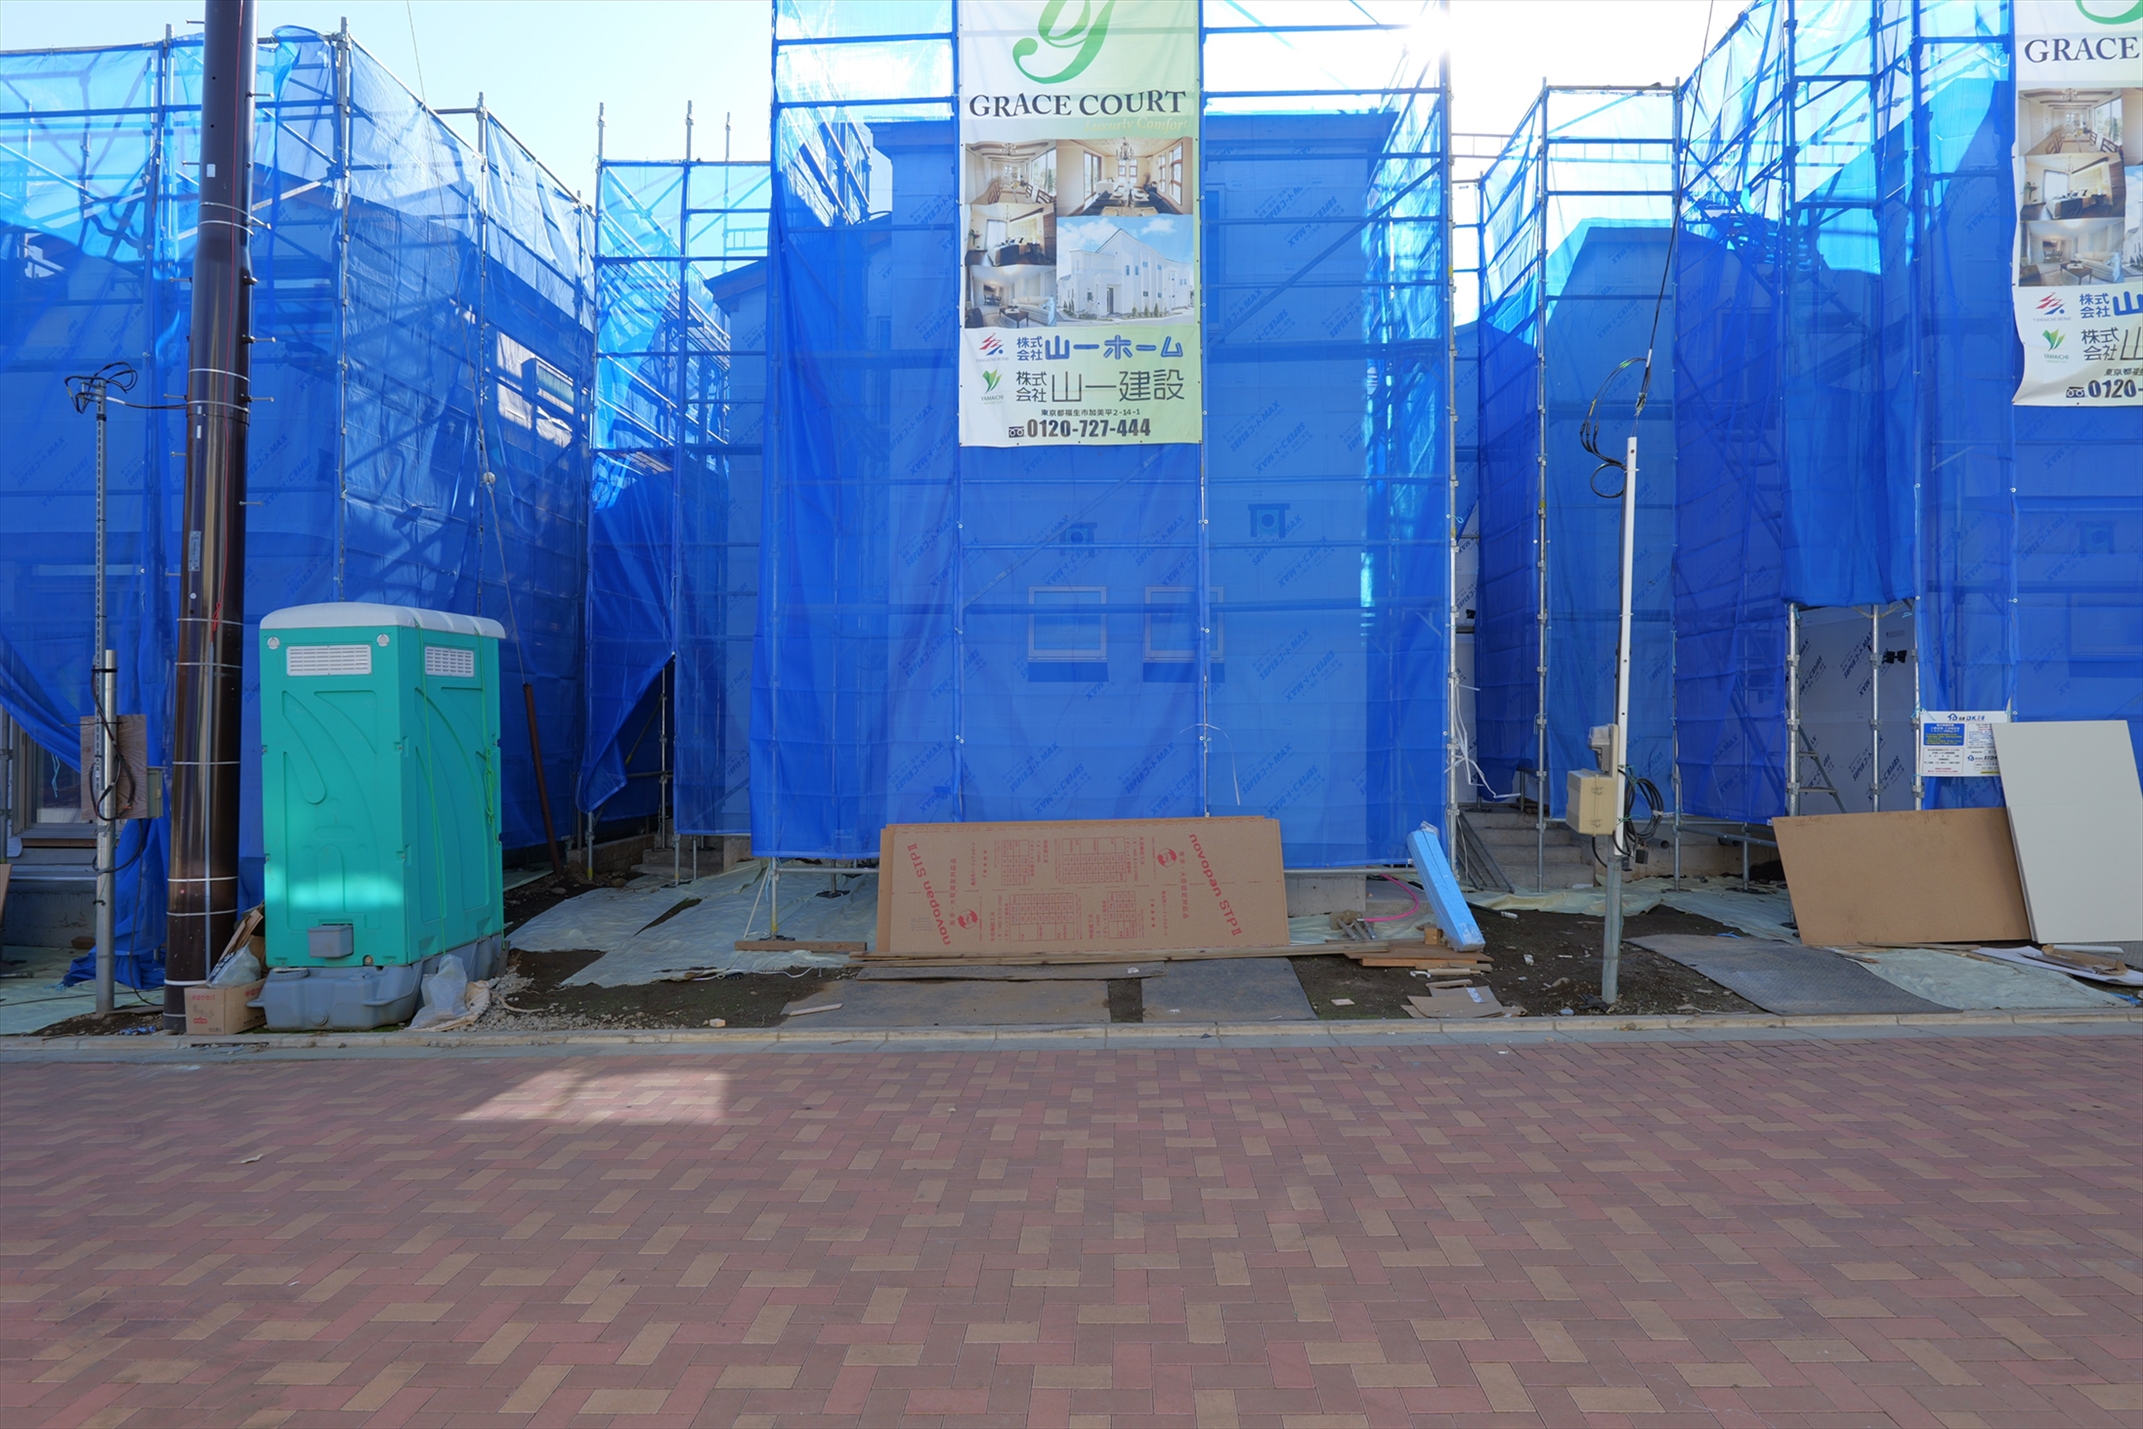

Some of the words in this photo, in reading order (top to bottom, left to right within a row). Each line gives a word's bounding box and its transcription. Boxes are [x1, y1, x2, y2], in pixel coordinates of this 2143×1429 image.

[2024, 36, 2141, 63] GRACE
[969, 92, 1072, 117] GRACE
[1078, 89, 1187, 116] COURT
[1137, 116, 1188, 133] Comfort
[2079, 292, 2110, 306] 株式
[2080, 306, 2111, 319] 会社
[1016, 335, 1043, 349] 株式
[2080, 326, 2120, 345] 株式
[1016, 349, 1043, 361] 会社
[1044, 334, 1184, 361] 山一ホーム
[2083, 344, 2118, 361] 会社
[1015, 370, 1048, 387] 株式
[1051, 368, 1185, 402] 山一建設
[1015, 387, 1048, 403] 会社
[1027, 418, 1151, 438] 0120-727-444
[1188, 833, 1222, 897] novopan
[923, 880, 952, 946] novopan
